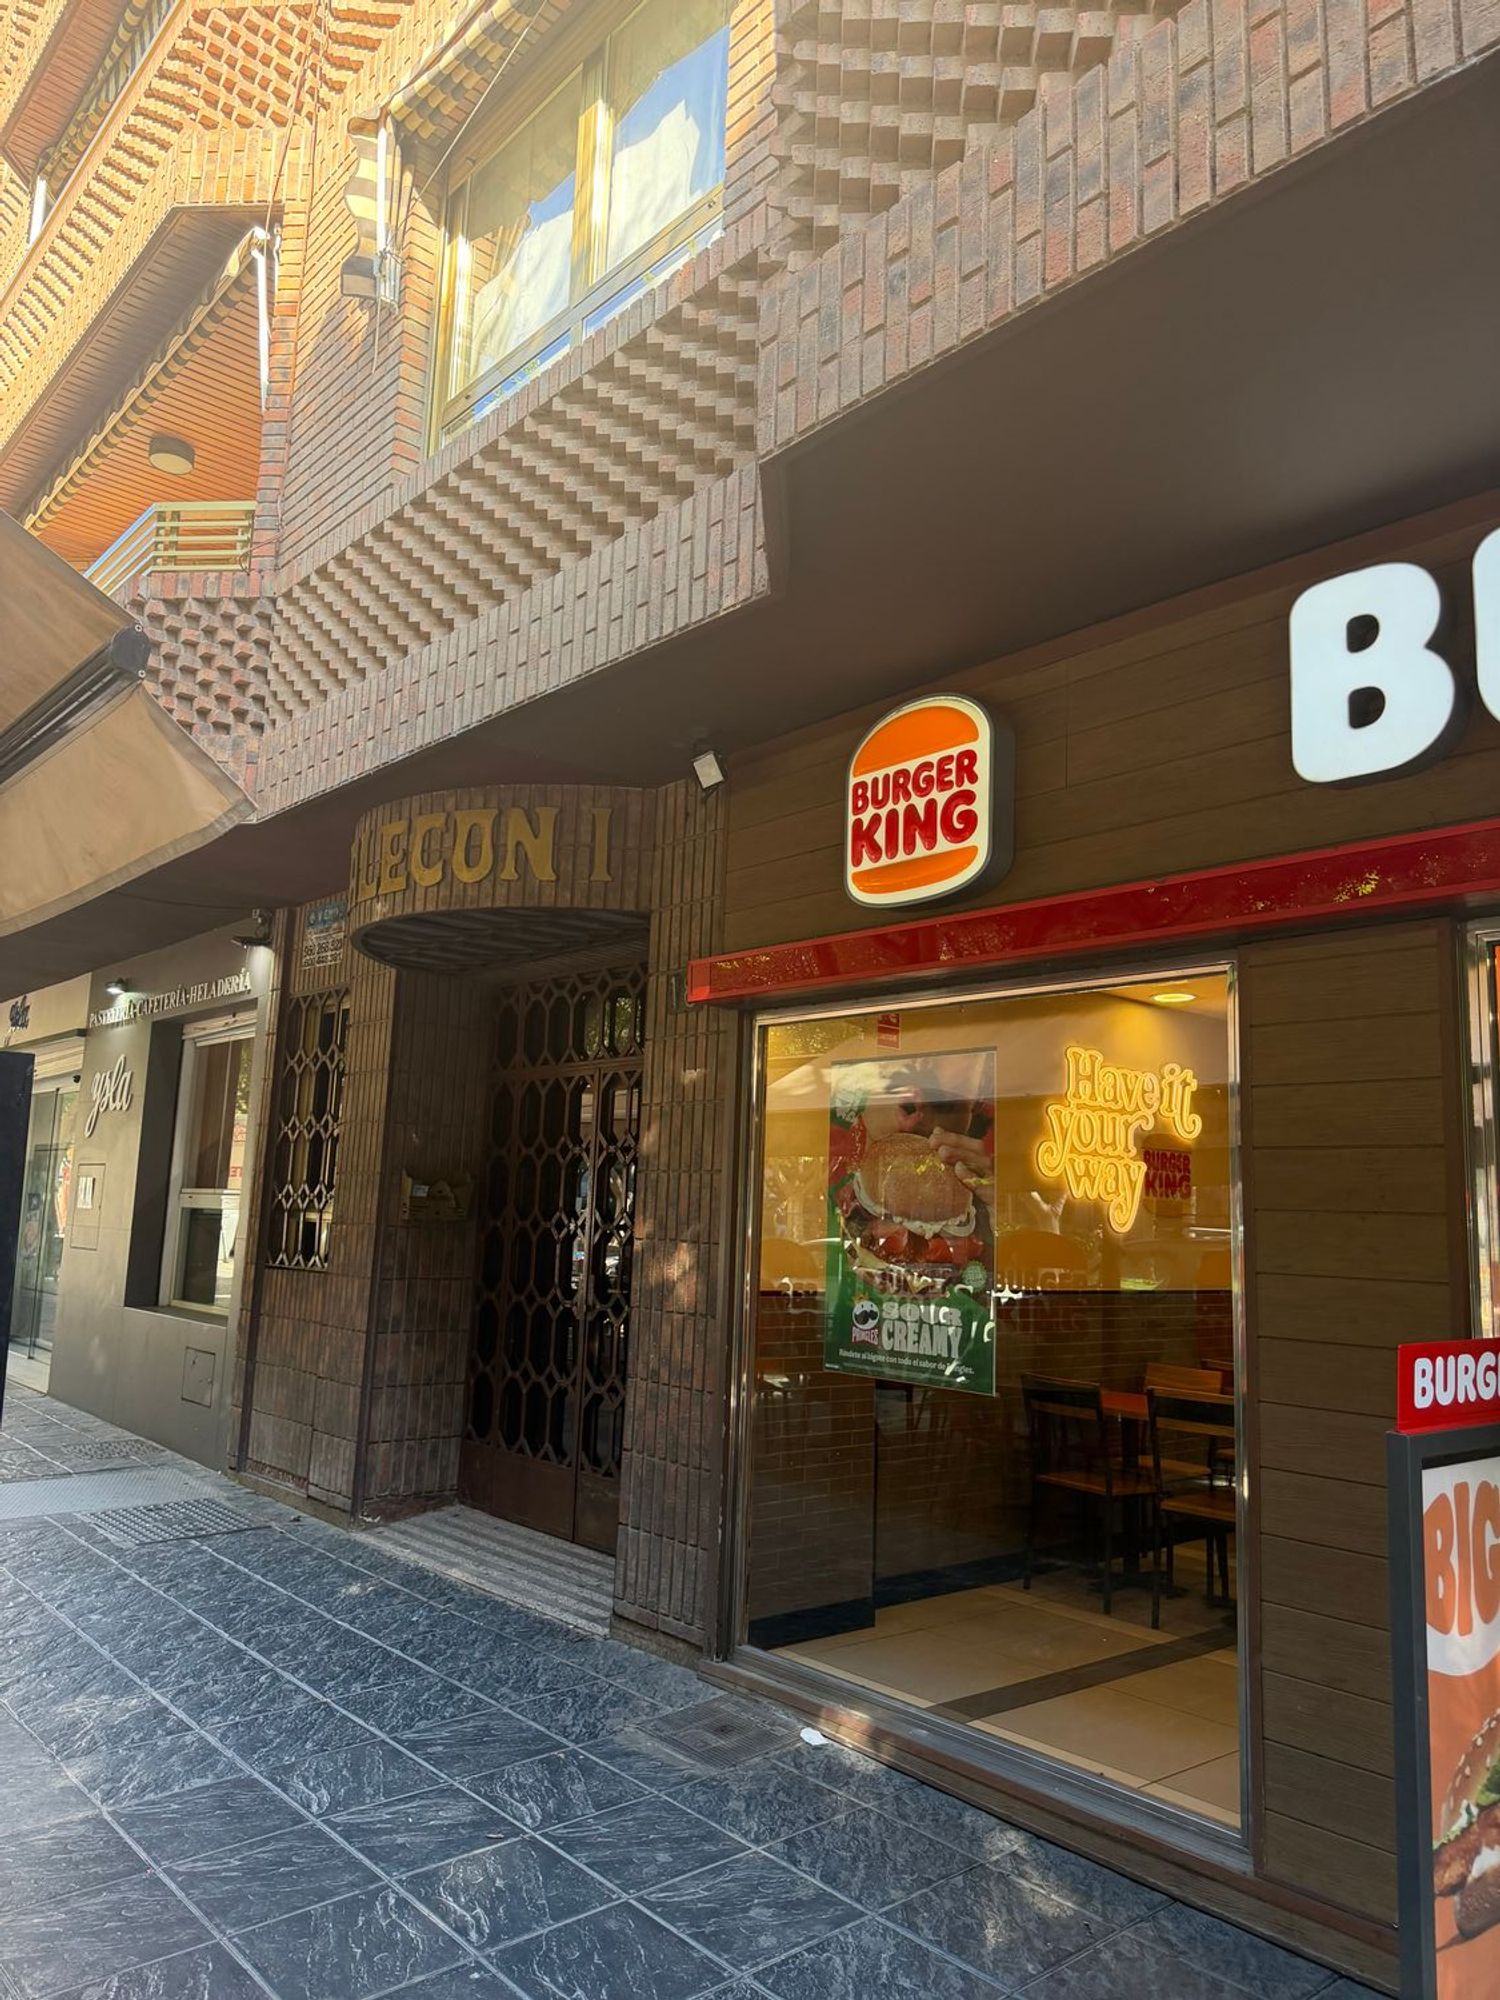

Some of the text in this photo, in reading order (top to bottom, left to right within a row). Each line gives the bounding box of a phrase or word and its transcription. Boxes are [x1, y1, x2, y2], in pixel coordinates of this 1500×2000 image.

[1289, 526, 1500, 783] B
[852, 749, 979, 816] BURGER
[590, 808, 613, 882] I
[851, 789, 979, 868] KING
[1066, 1046, 1202, 1139] Have it
[1037, 1104, 1154, 1177] your
[1143, 1149, 1191, 1174] BURGER
[1065, 1154, 1147, 1233] way
[1144, 1171, 1191, 1199] KING
[881, 1320, 962, 1358] CREAMY
[882, 1301, 962, 1326] SOUR
[1414, 1351, 1500, 1409] BURG
[1424, 1481, 1500, 1637] BIG
